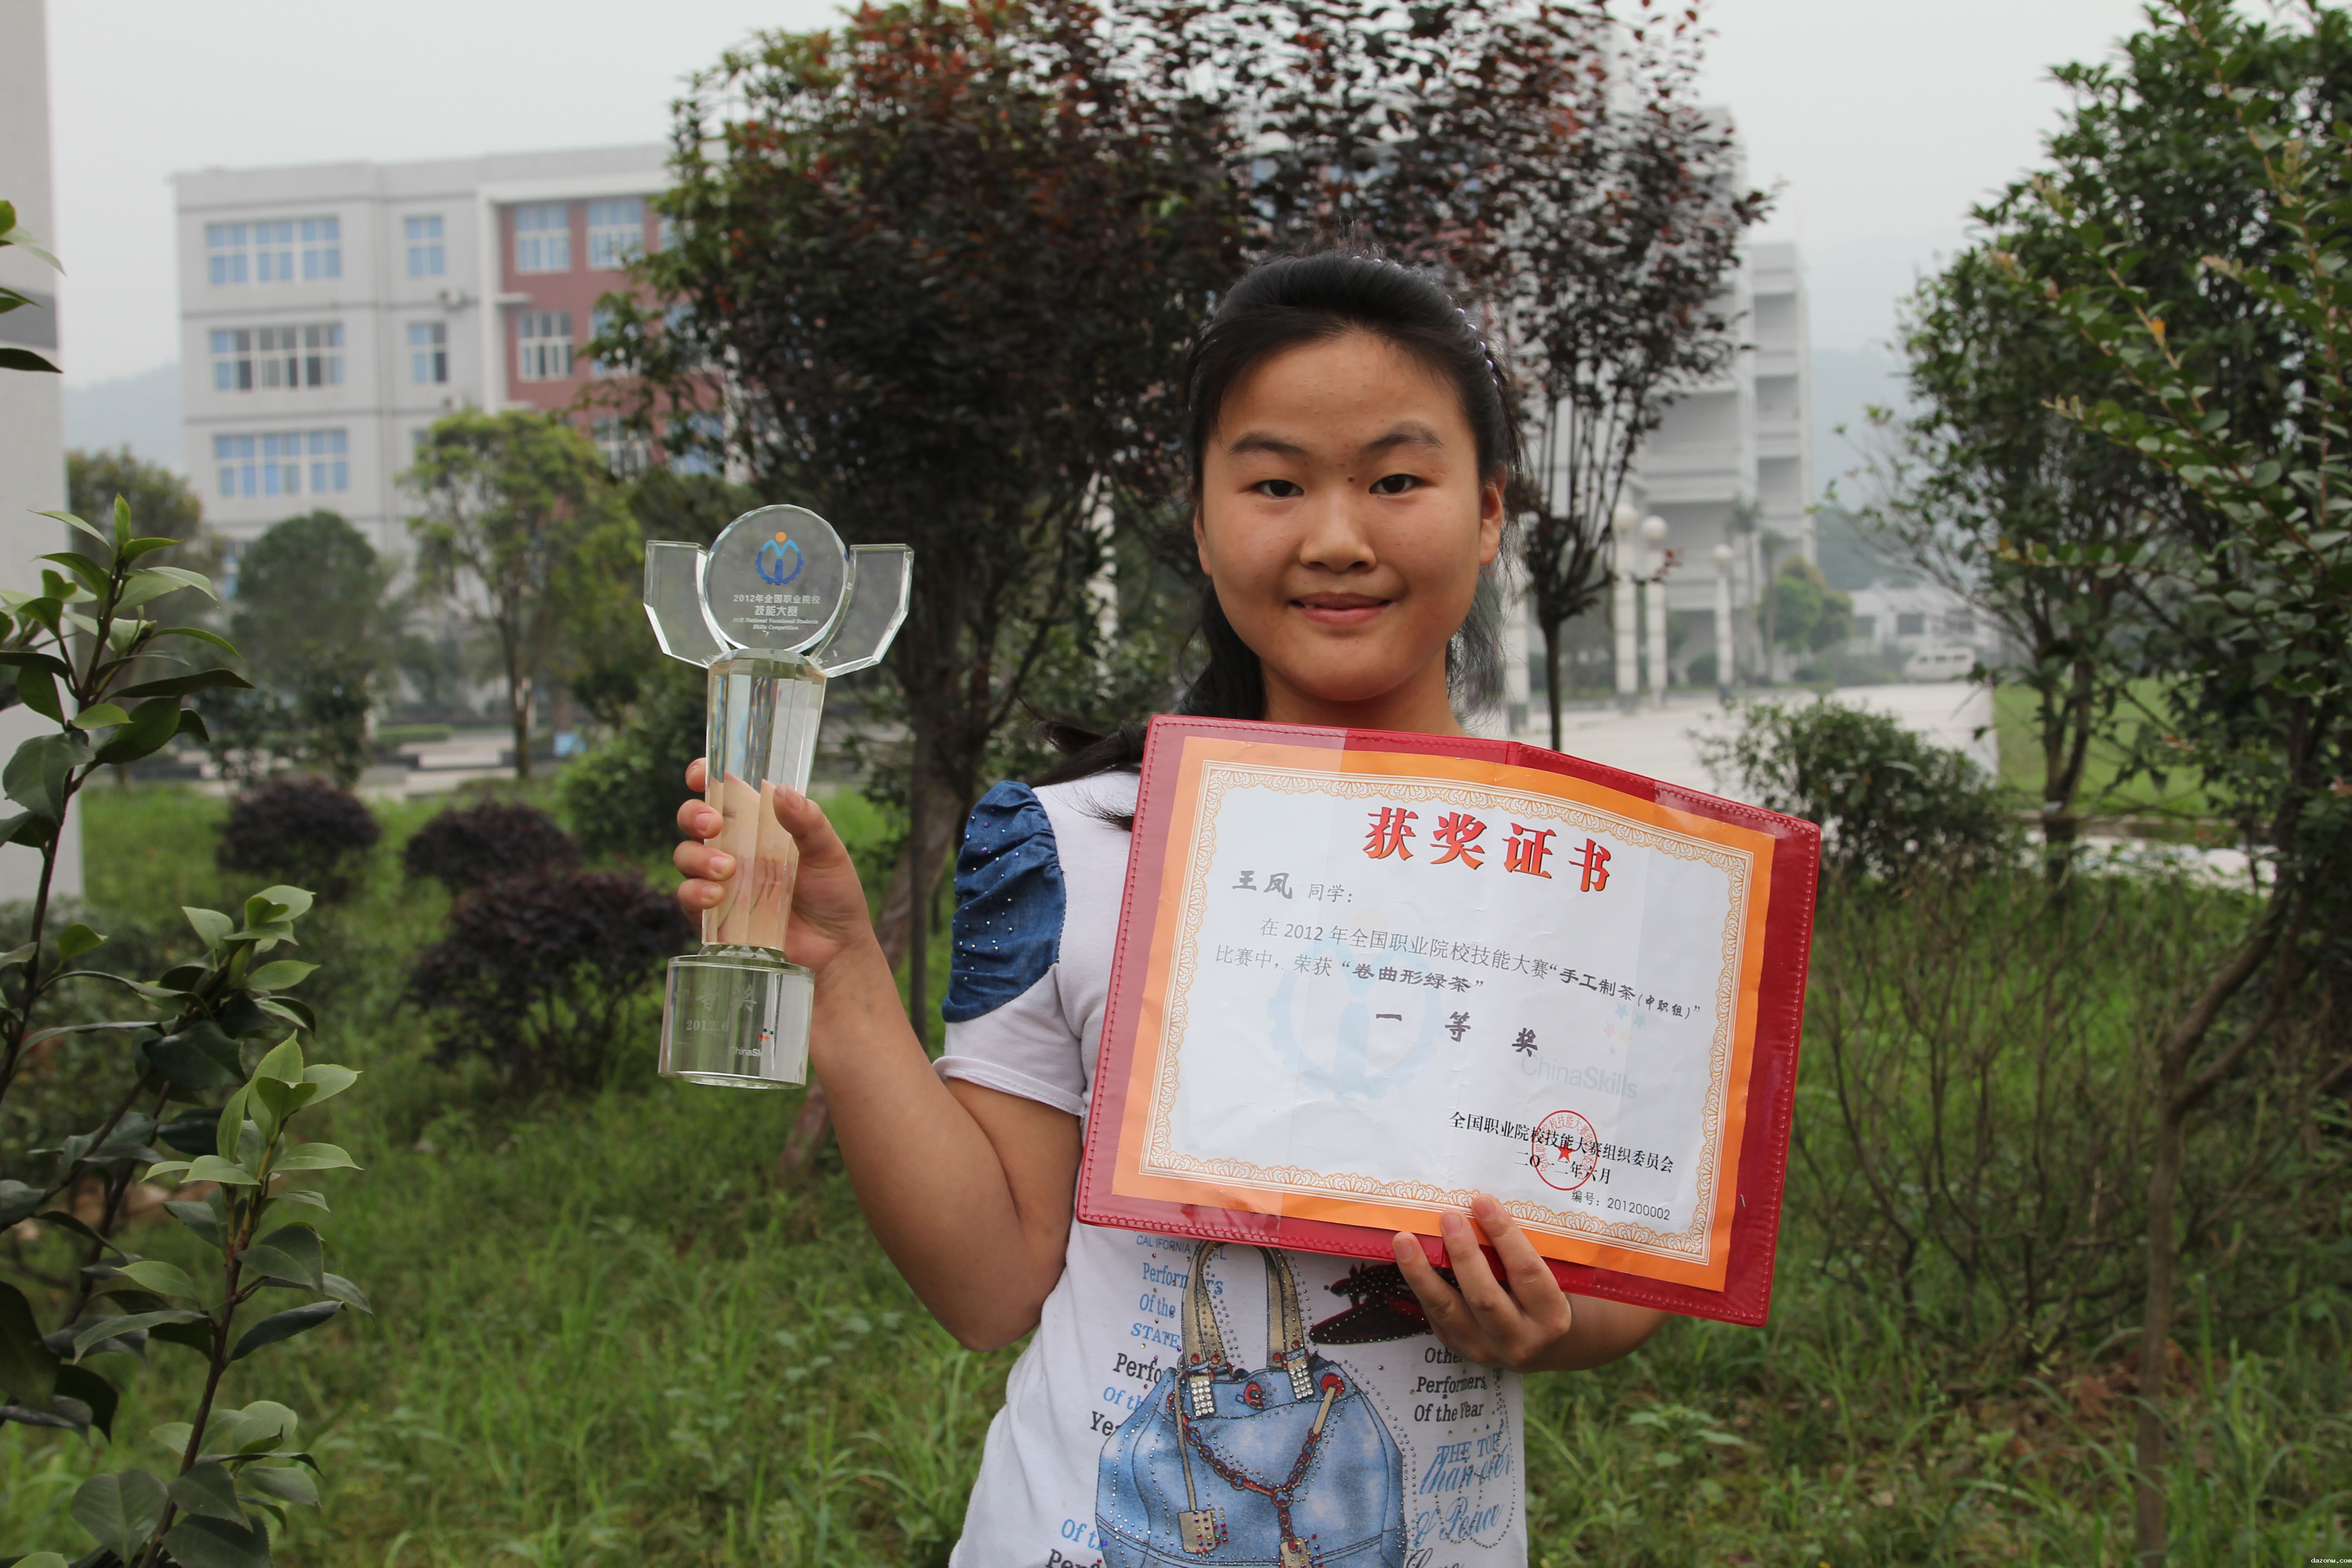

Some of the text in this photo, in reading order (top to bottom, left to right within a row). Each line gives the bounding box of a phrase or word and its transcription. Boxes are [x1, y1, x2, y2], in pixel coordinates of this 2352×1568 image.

[733, 594, 821, 604] 2012年全国职业院校
[754, 605, 799, 617] 技能大赛
[1362, 806, 1612, 892] 获奖证书
[1232, 870, 1293, 900] 王凤
[1376, 1011, 1538, 1058] 一等奖
[1520, 1054, 1638, 1099] ChinaSkills
[1449, 1111, 1674, 1174] 全国职业院校技能大赛组织委员会
[1140, 1294, 1176, 1318] Of the
[1131, 1323, 1181, 1348] STATE
[1103, 1387, 1126, 1405] Of
[1416, 1376, 1486, 1393] Performers
[1090, 1411, 1122, 1436] Ye
[1414, 1402, 1485, 1422] Of the Year
[1436, 1432, 1501, 1465] THE TOP
[1061, 1519, 1087, 1543] Of
